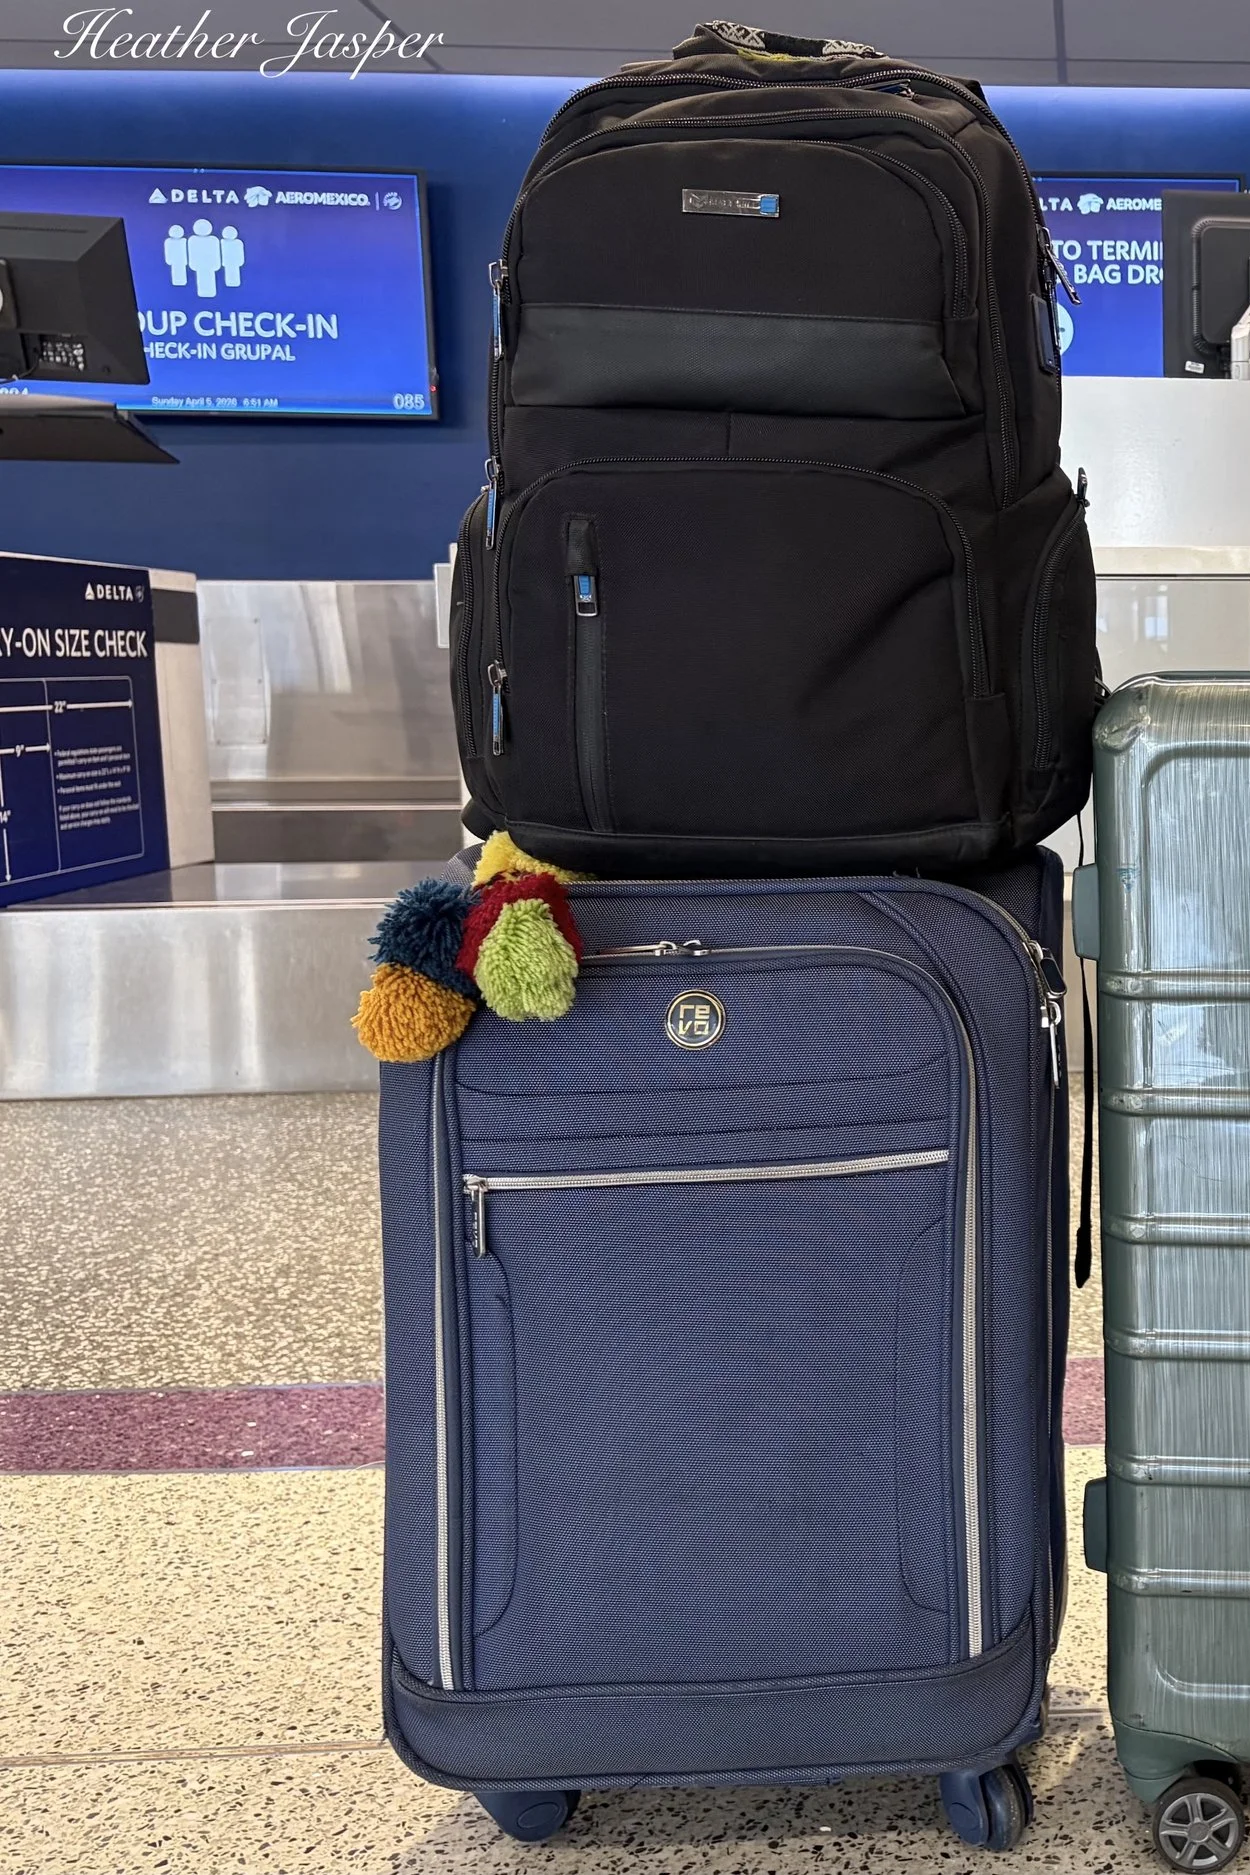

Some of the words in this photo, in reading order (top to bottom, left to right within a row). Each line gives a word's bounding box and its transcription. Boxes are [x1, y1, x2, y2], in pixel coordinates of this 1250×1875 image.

[171, 188, 240, 204] DELTA
[274, 190, 371, 207] AEROMEXICO
[1052, 239, 1082, 261] TO
[1086, 240, 1163, 261] TERMI
[1073, 263, 1122, 285] BAG
[1127, 264, 1163, 285] DR
[194, 311, 338, 340] CHECK-IN
[221, 343, 296, 362] GRUPAL
[151, 396, 183, 408] Sunday
[185, 396, 204, 408] April
[263, 398, 279, 408] AM
[392, 392, 425, 411] 085
[96, 583, 134, 601] DELTA
[0, 627, 51, 657] Y-ON
[54, 628, 91, 657] SIZE
[94, 629, 148, 658] CHECK
